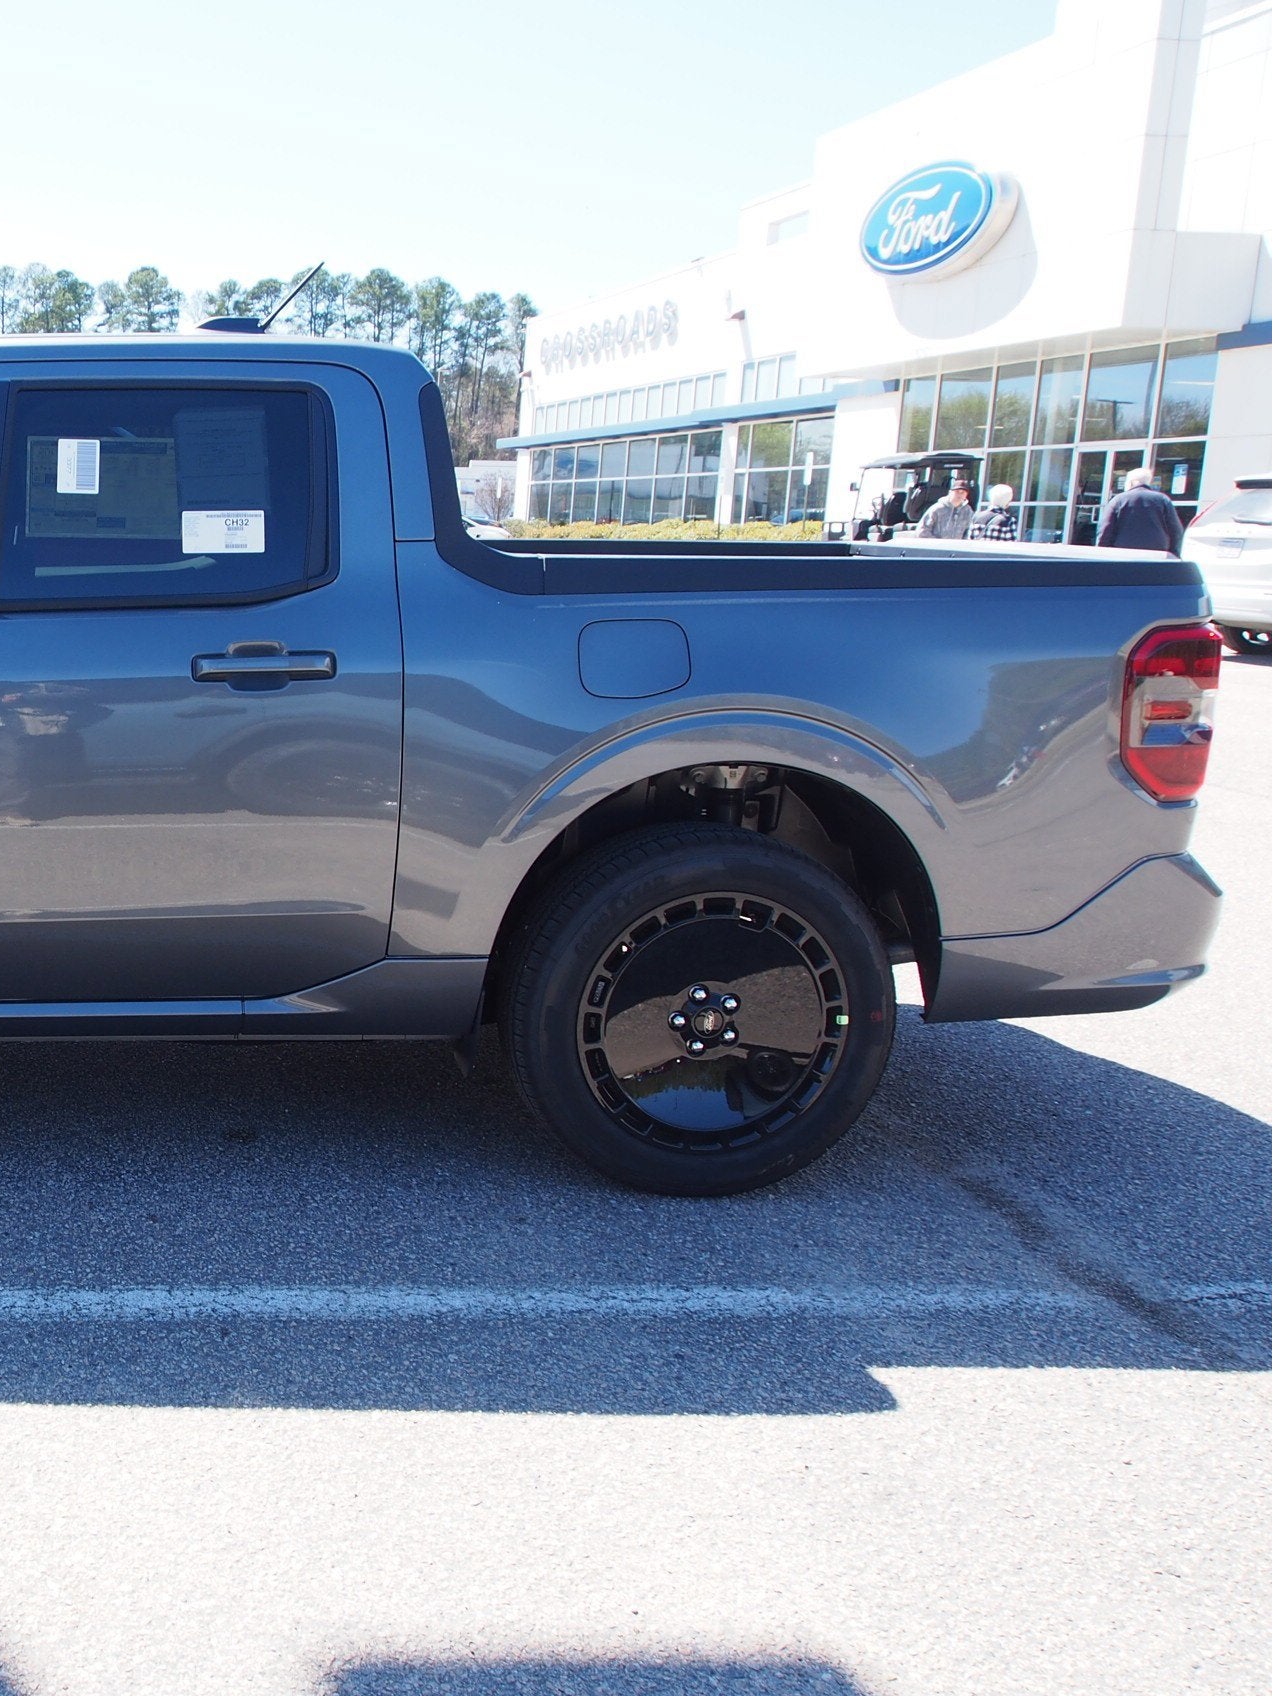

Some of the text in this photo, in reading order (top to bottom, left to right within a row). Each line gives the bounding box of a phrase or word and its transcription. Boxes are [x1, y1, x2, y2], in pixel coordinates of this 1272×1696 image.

[878, 183, 963, 260] Ford
[540, 299, 678, 366] CROSSROADS
[224, 518, 250, 527] CH32
